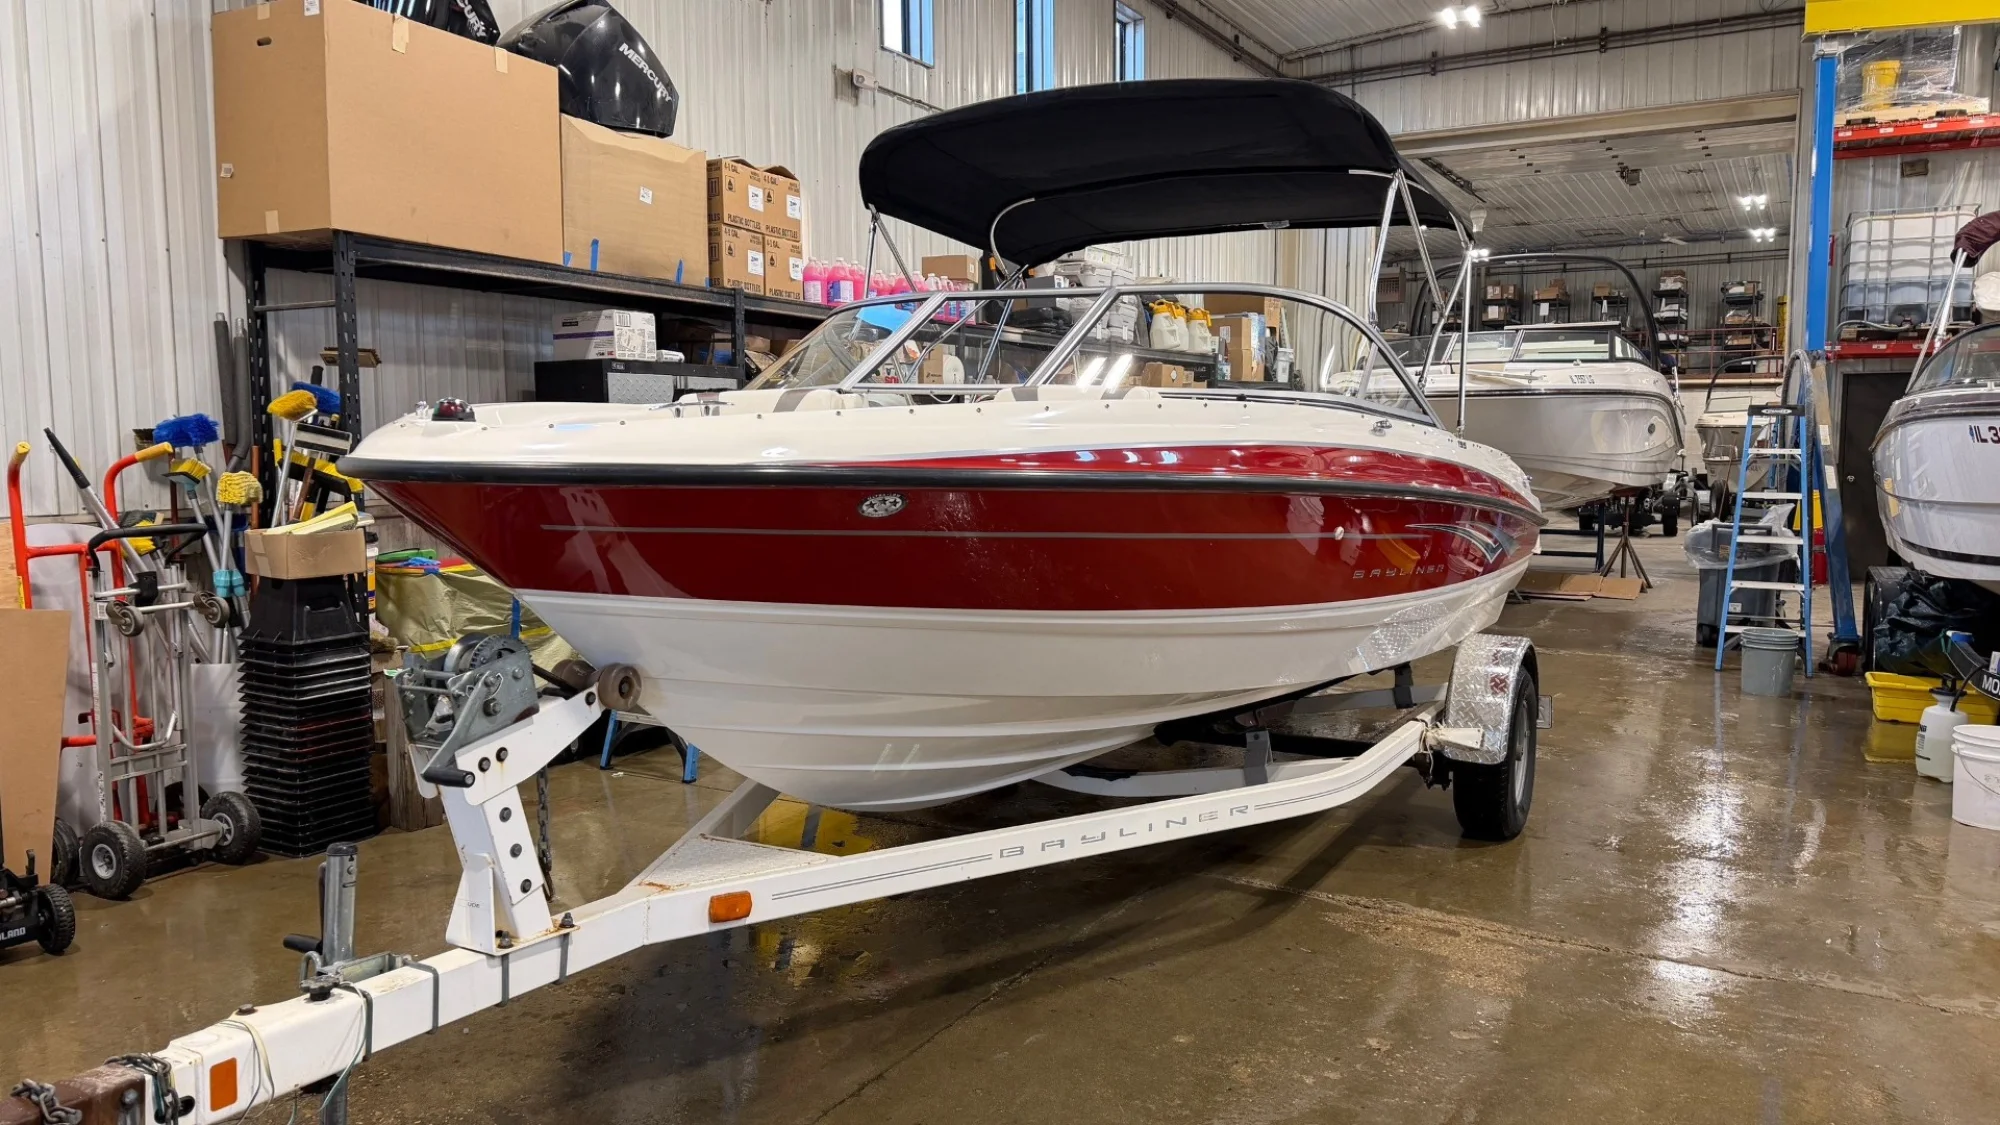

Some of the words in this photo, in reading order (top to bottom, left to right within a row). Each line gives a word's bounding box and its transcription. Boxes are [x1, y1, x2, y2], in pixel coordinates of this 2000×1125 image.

[618, 42, 672, 101] MERCURY
[728, 213, 743, 225] PLASTIC
[744, 217, 761, 229] BOTTLES
[765, 225, 781, 237] PLASTIC
[782, 228, 798, 239] BOTTLES
[727, 278, 743, 288] PLASTIC
[744, 280, 761, 292] BOTTLES
[769, 288, 784, 297] PLASTIC
[1973, 425, 1988, 443] IL
[1988, 426, 2000, 444] 3
[1353, 564, 1444, 578] BAYLINER
[1982, 674, 2000, 696] MO
[1000, 804, 1249, 859] BAYLINER
